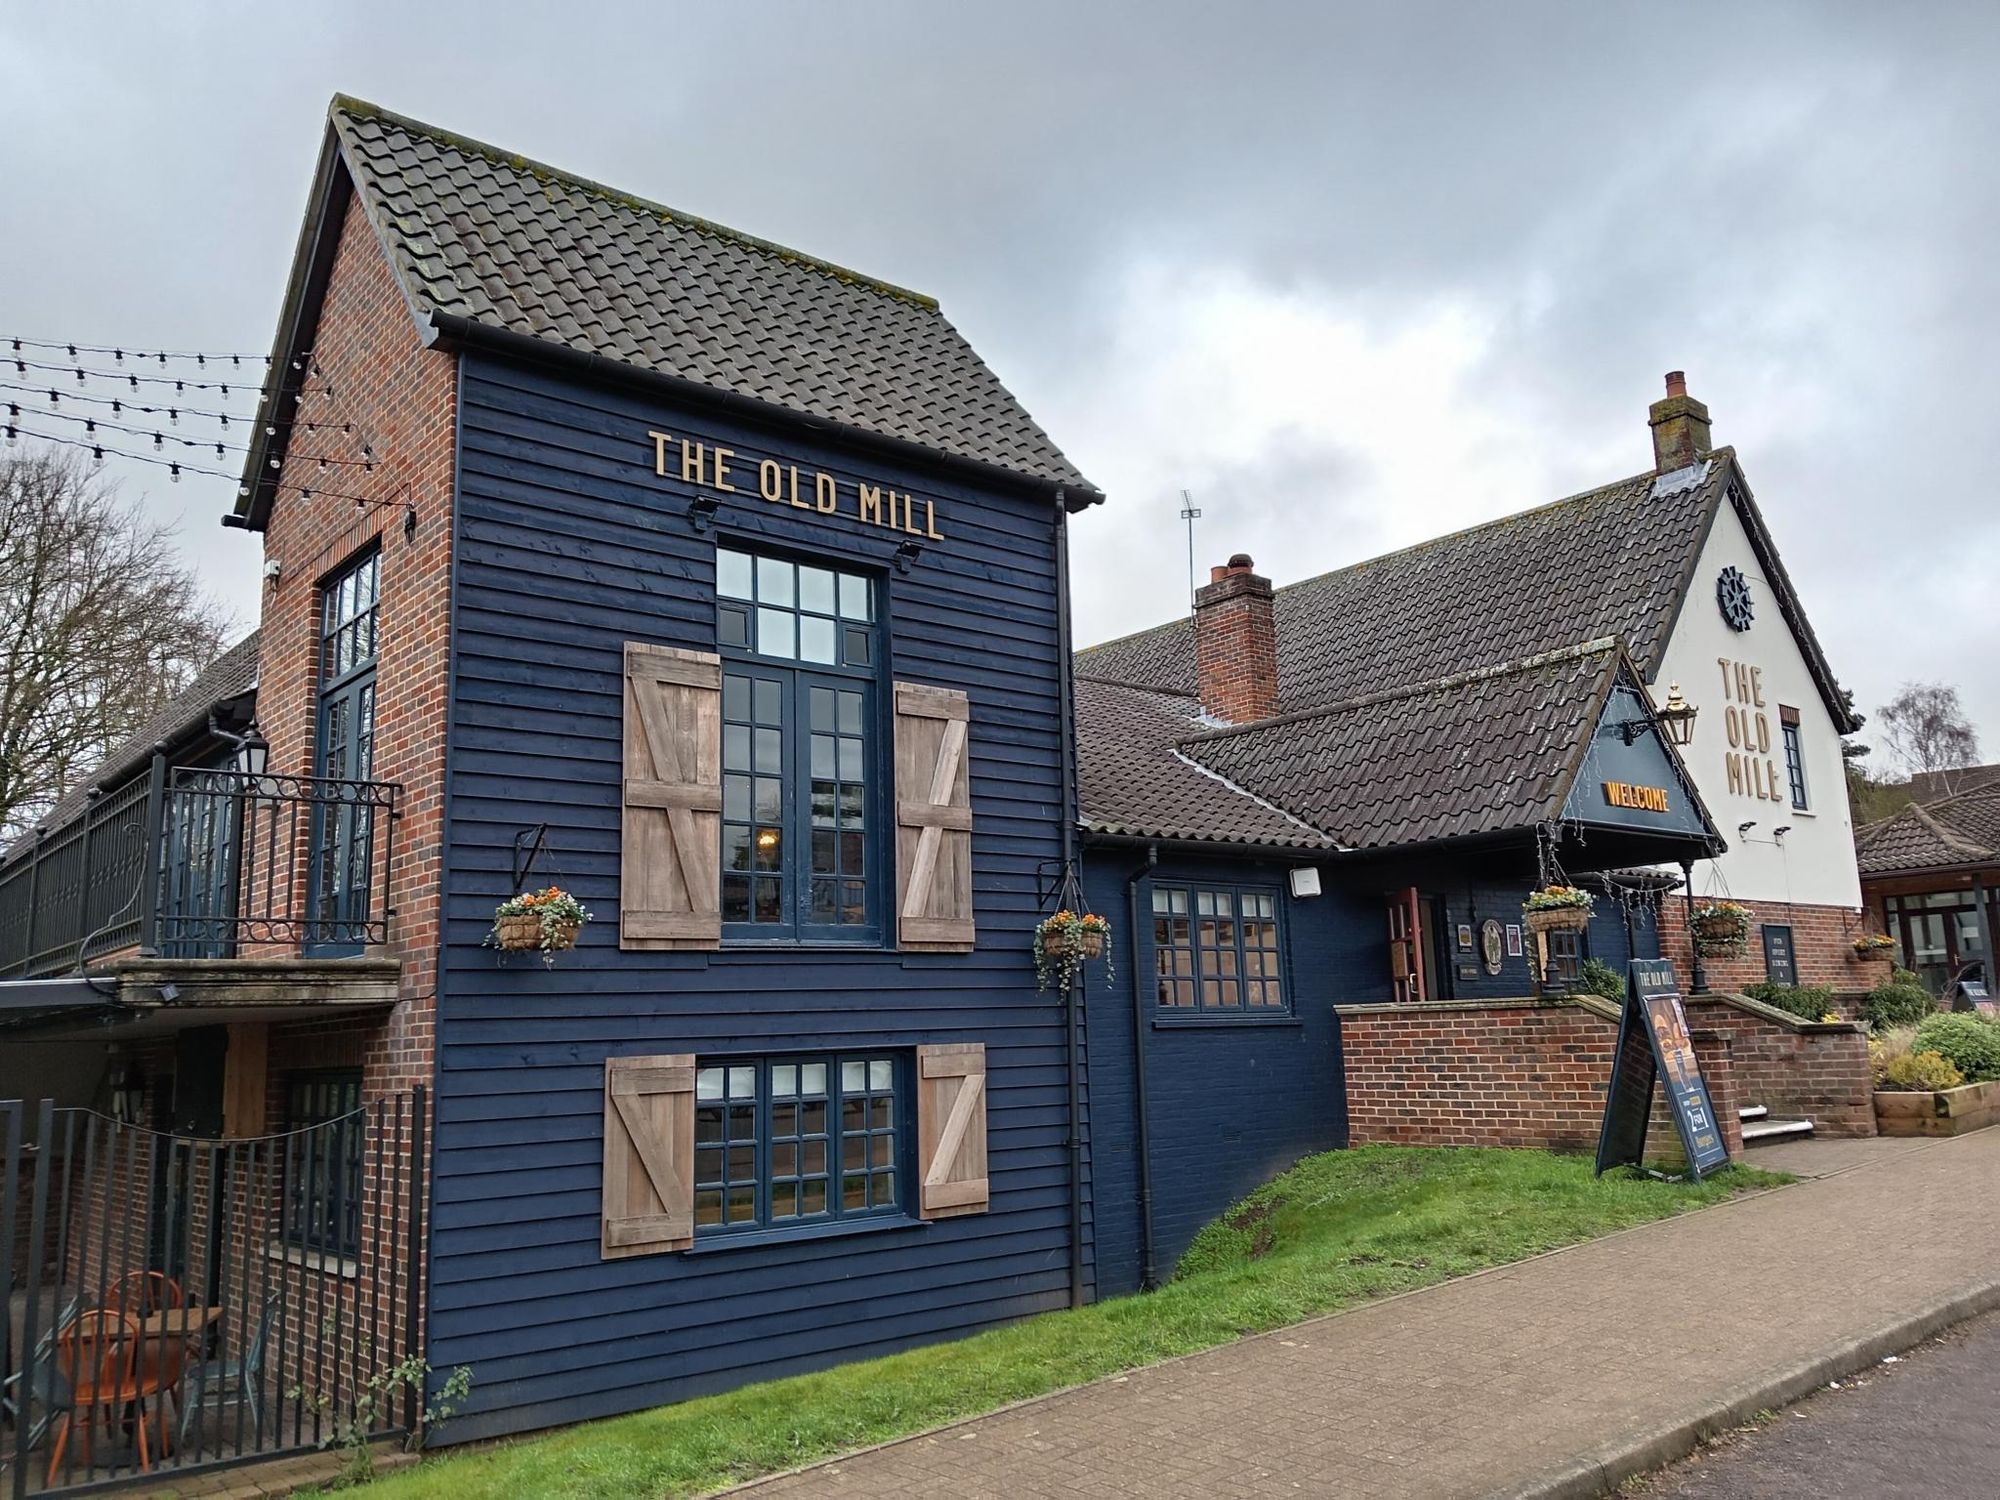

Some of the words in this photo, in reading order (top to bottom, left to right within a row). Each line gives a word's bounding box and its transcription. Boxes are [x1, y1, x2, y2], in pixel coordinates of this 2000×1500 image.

[648, 430, 736, 492] THE
[760, 459, 837, 514] OLD
[859, 483, 945, 541] MILL
[1718, 657, 1766, 707] THE
[1725, 705, 1771, 753] OLD
[1604, 781, 1670, 812] WELCOME
[1725, 752, 1783, 801] MILL
[1639, 972, 1651, 986] THE
[1650, 972, 1661, 986] OLD
[1687, 1110, 1697, 1132] 2
[1699, 1107, 1709, 1127] 1
